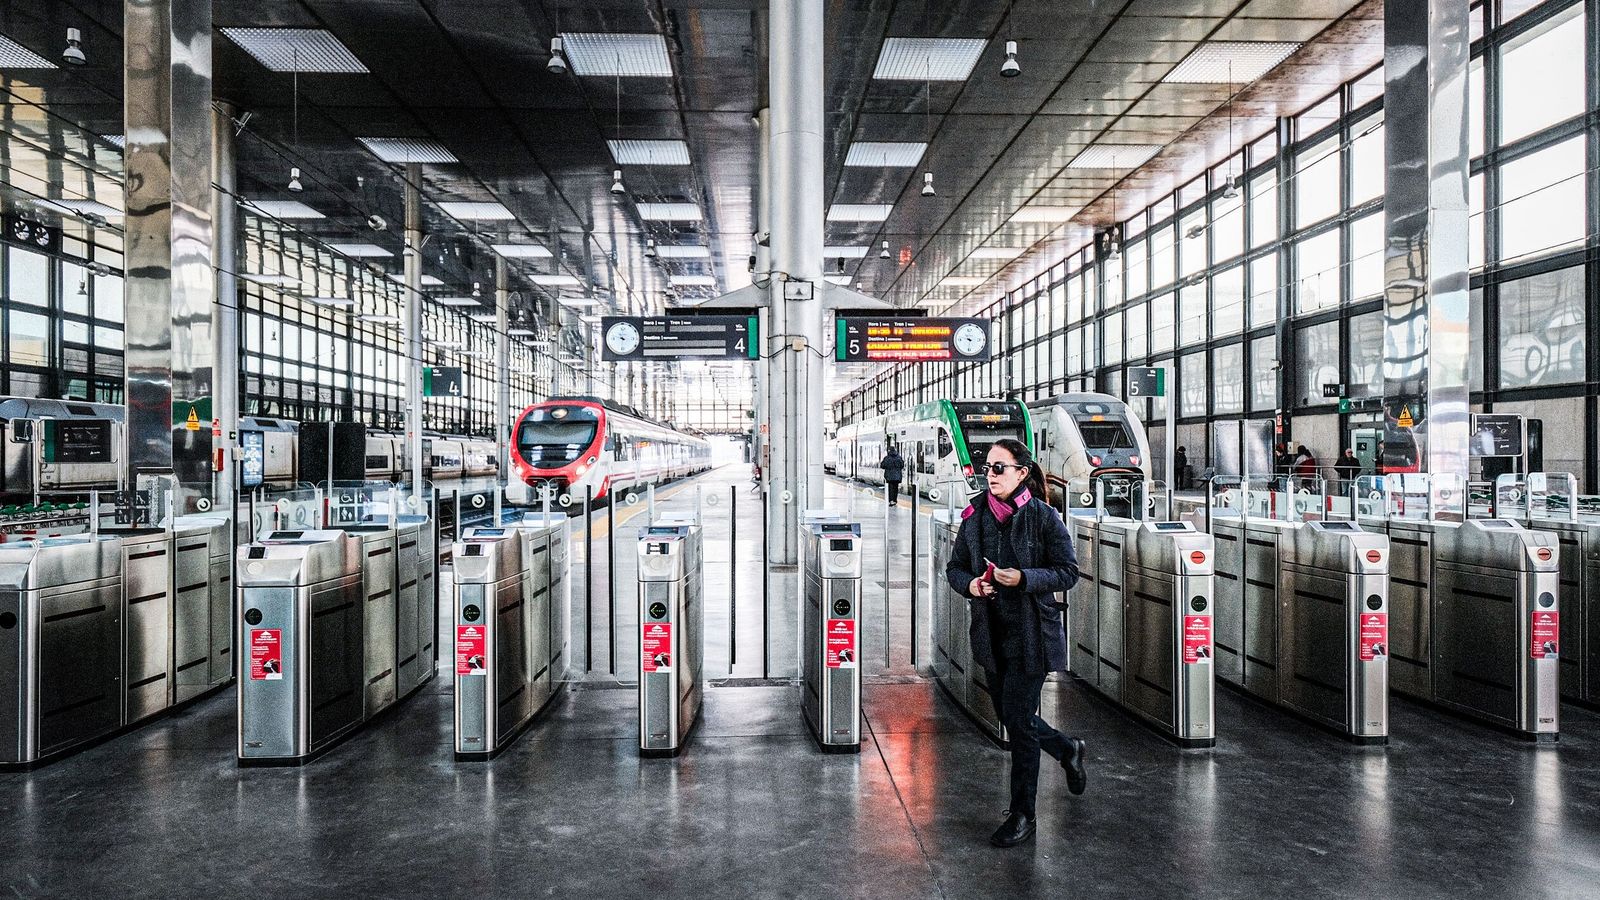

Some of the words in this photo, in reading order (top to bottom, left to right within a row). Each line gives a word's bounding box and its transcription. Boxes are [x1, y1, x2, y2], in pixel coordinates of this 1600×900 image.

[734, 338, 746, 353] 4
[849, 340, 860, 354] 5
[449, 381, 459, 395] 4
[1131, 381, 1139, 395] 5
